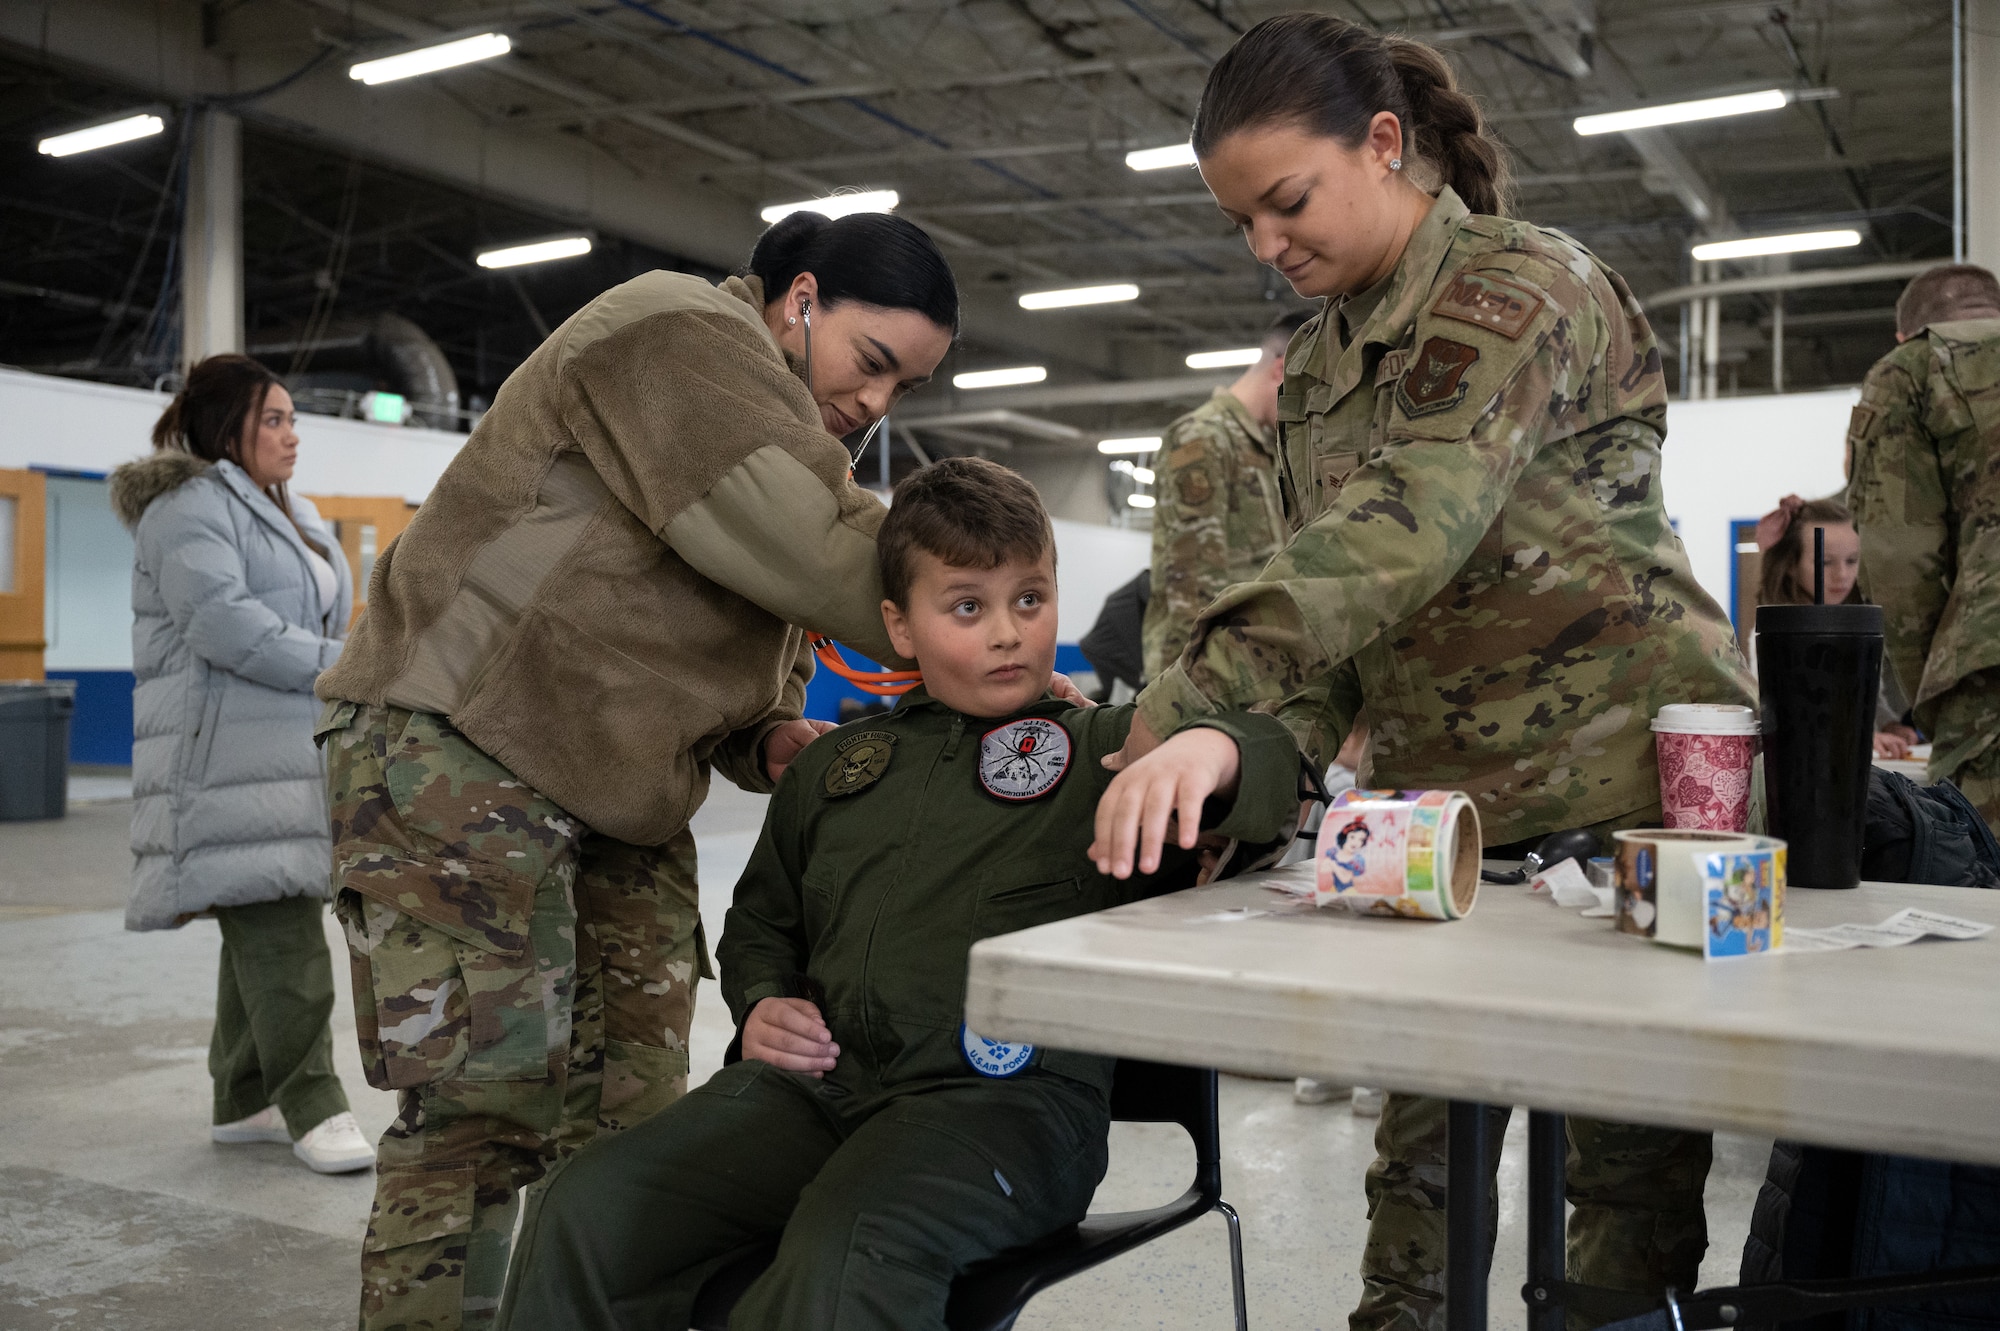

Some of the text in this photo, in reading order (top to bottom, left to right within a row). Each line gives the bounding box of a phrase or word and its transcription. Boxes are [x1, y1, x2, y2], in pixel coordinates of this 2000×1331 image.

[839, 732, 870, 750] FIGHTIN'
[988, 782, 1036, 797] THROUGHOUT
[1037, 769, 1061, 792] FEARED
[1003, 1044, 1030, 1072] FORCE
